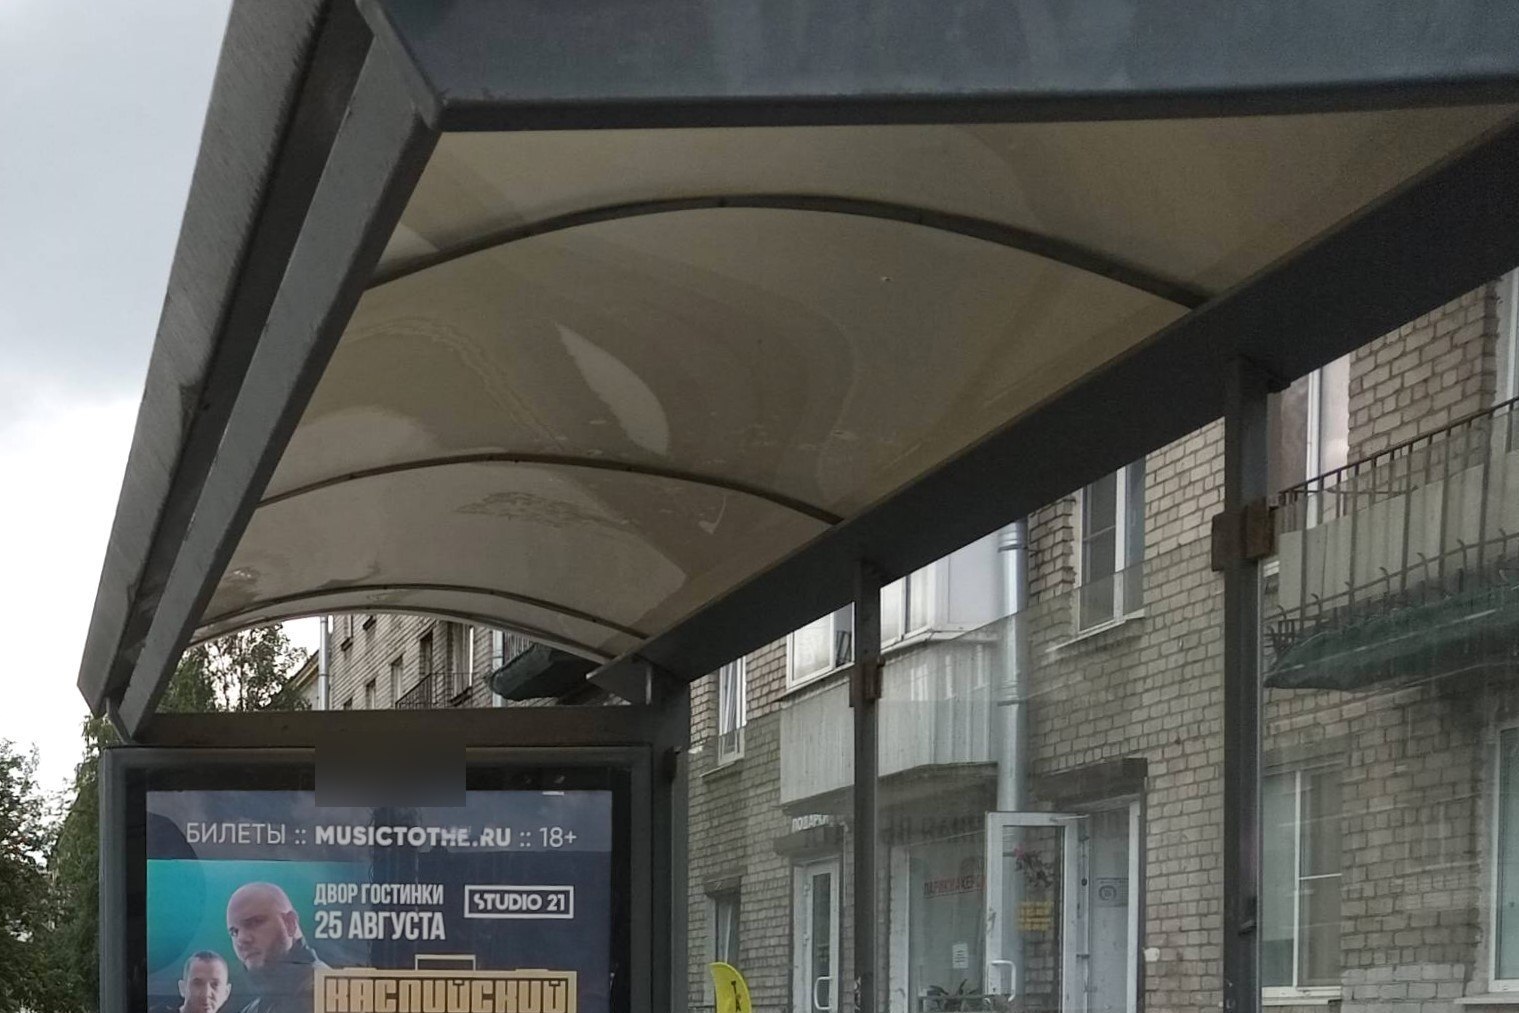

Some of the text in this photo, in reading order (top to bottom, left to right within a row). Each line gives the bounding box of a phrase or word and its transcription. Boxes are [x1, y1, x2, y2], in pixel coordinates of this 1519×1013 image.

[186, 822, 286, 846] БИЛЕТЫ
[315, 826, 511, 848] MUSICTOTHE.RU
[539, 827, 578, 848] 18+
[314, 884, 444, 906] ДВОР ГОСТИНКИ
[473, 893, 566, 911] STUDIO 21
[314, 911, 445, 940] 25 АВГУСТА
